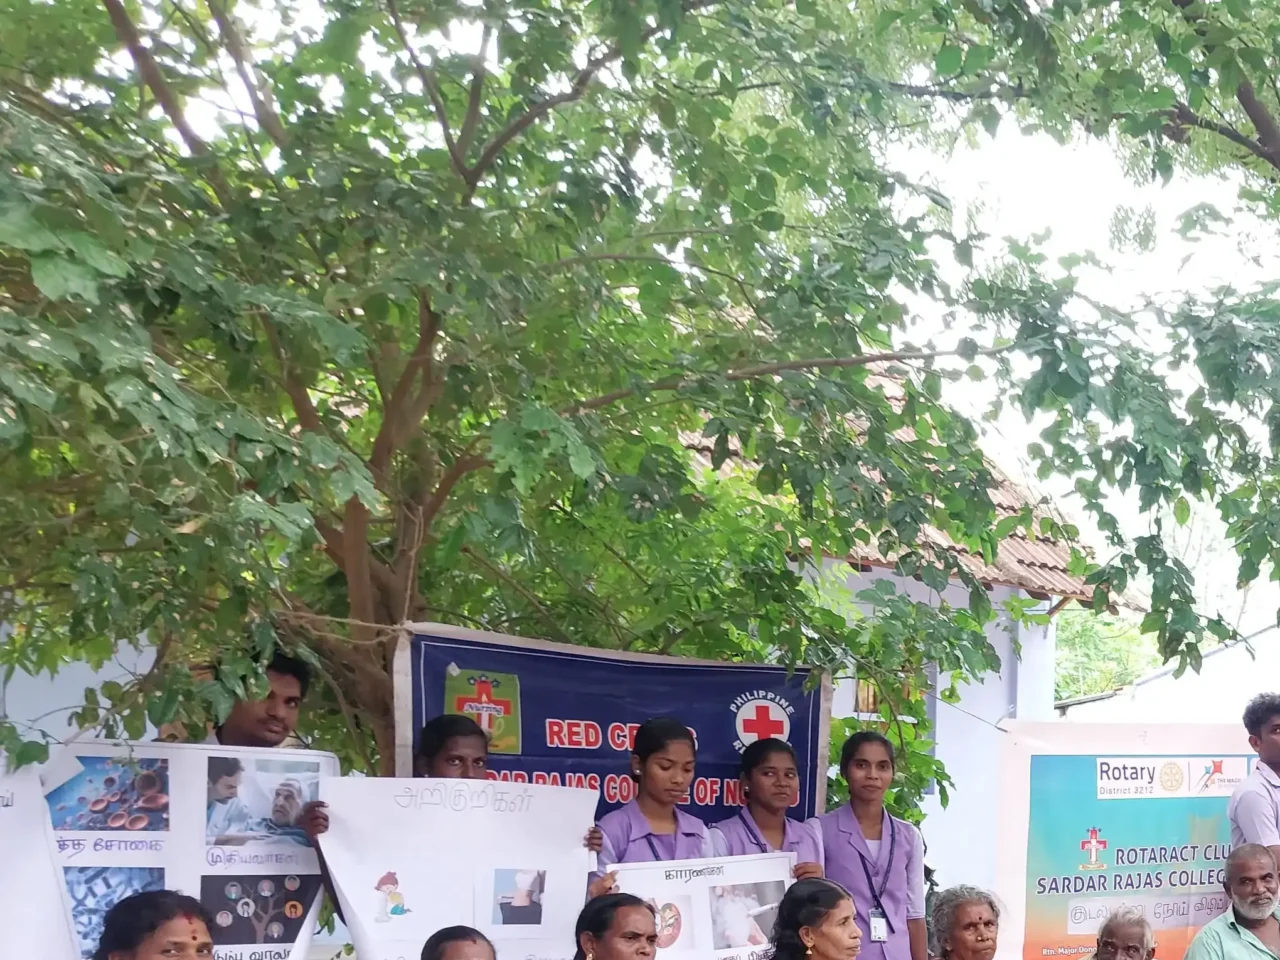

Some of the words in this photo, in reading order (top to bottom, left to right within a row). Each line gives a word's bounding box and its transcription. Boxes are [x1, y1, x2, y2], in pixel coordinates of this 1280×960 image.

[730, 690, 795, 715] PHILIPPINE
[545, 719, 602, 748] RED
[1100, 762, 1155, 784] Rotary
[694, 777, 721, 805] OF
[1100, 787, 1131, 795] District
[1134, 786, 1154, 794] 3212
[1116, 846, 1199, 866] ROTARACT
[1203, 844, 1231, 861] CLU
[1037, 875, 1108, 894] SARDAR
[1114, 871, 1163, 890] RAJAS
[1169, 869, 1226, 887] COLLEG
[1194, 896, 1228, 916] விழிப்
[1058, 947, 1077, 957] Major
